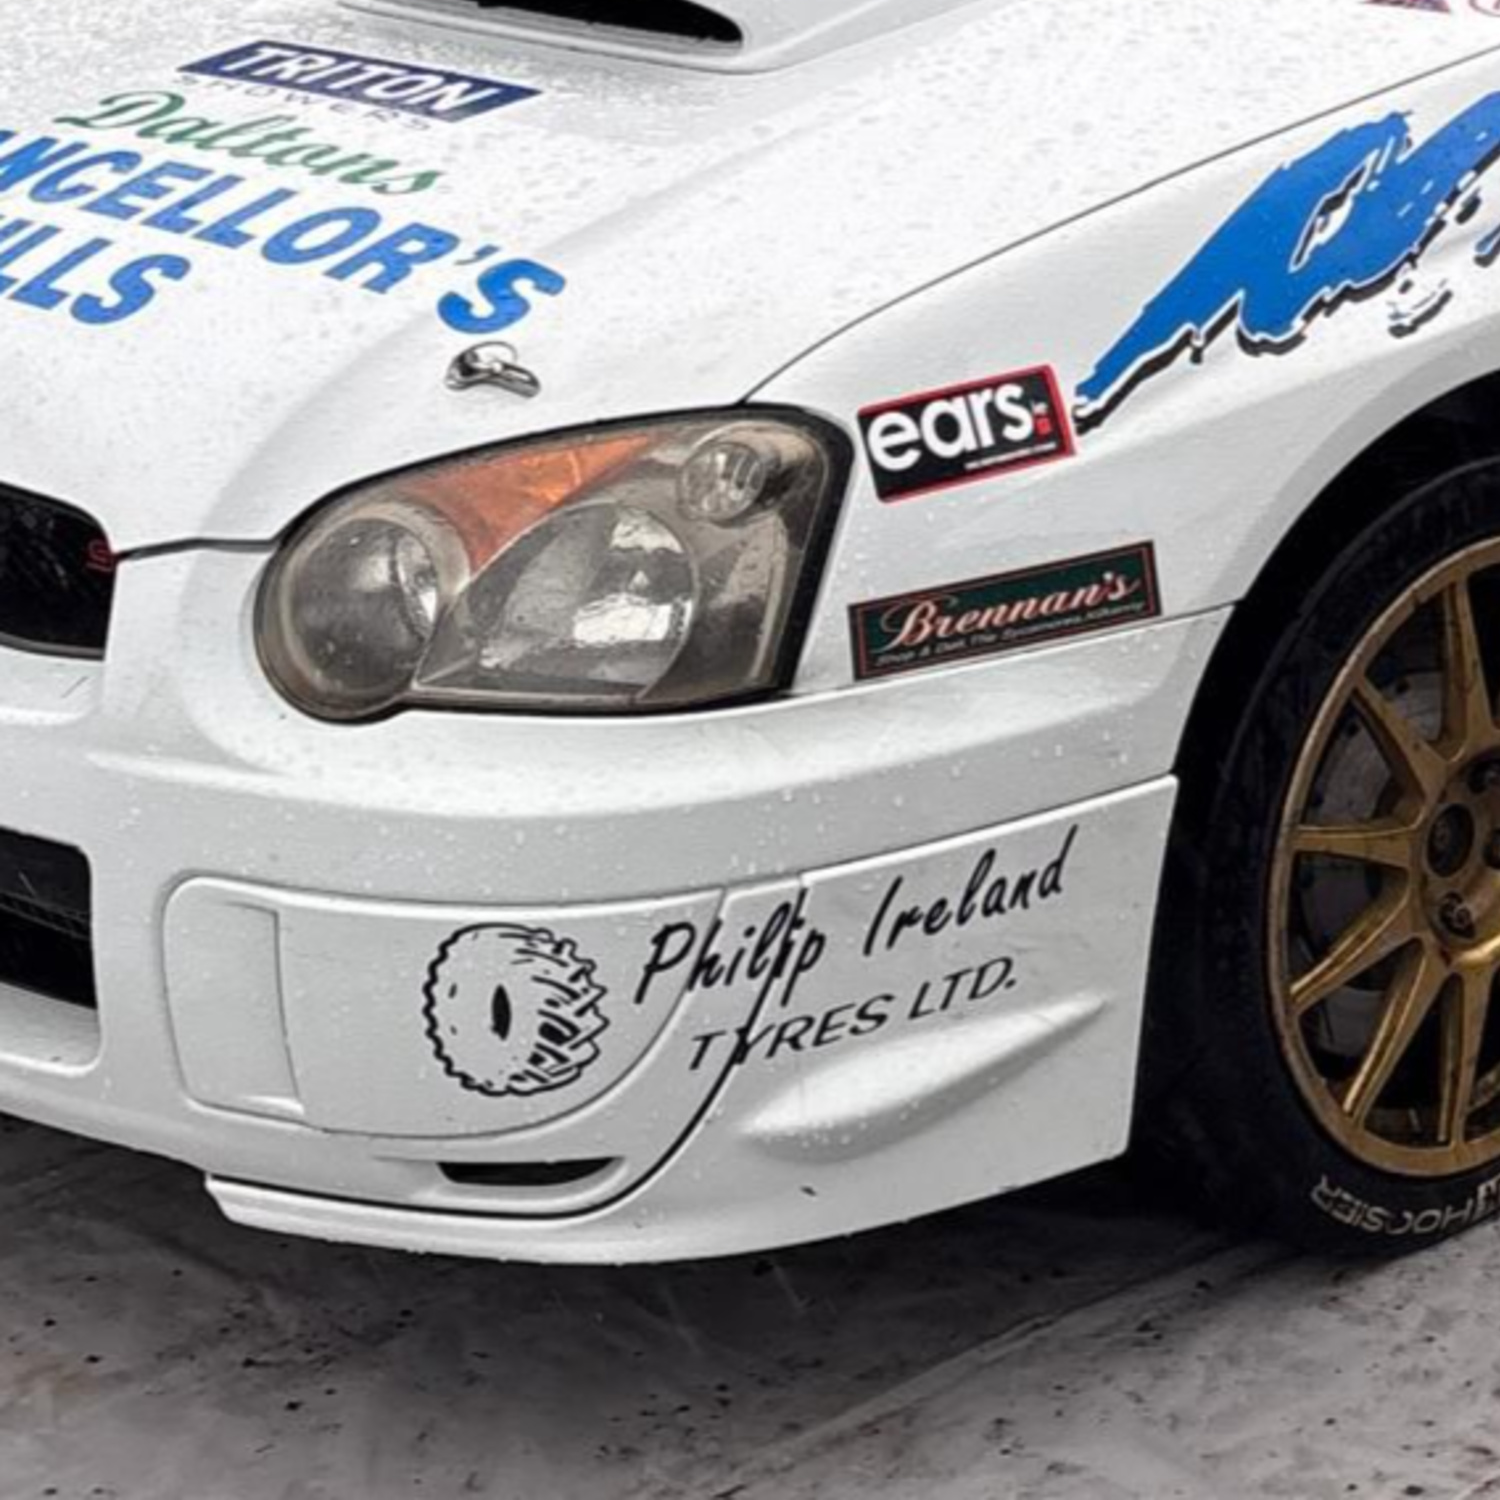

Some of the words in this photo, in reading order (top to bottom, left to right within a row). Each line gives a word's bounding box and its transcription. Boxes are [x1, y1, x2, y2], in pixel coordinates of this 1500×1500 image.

[173, 74, 432, 131] SHOWERS
[219, 46, 503, 115] TRITON
[53, 90, 446, 195] Daltons
[0, 130, 567, 335] NCELLOR'S
[870, 571, 1142, 654] Brennan's
[632, 891, 827, 1007] Philip
[863, 824, 1079, 957] Ireland
[689, 993, 896, 1071] TYRES
[907, 955, 1018, 1020] LTD.
